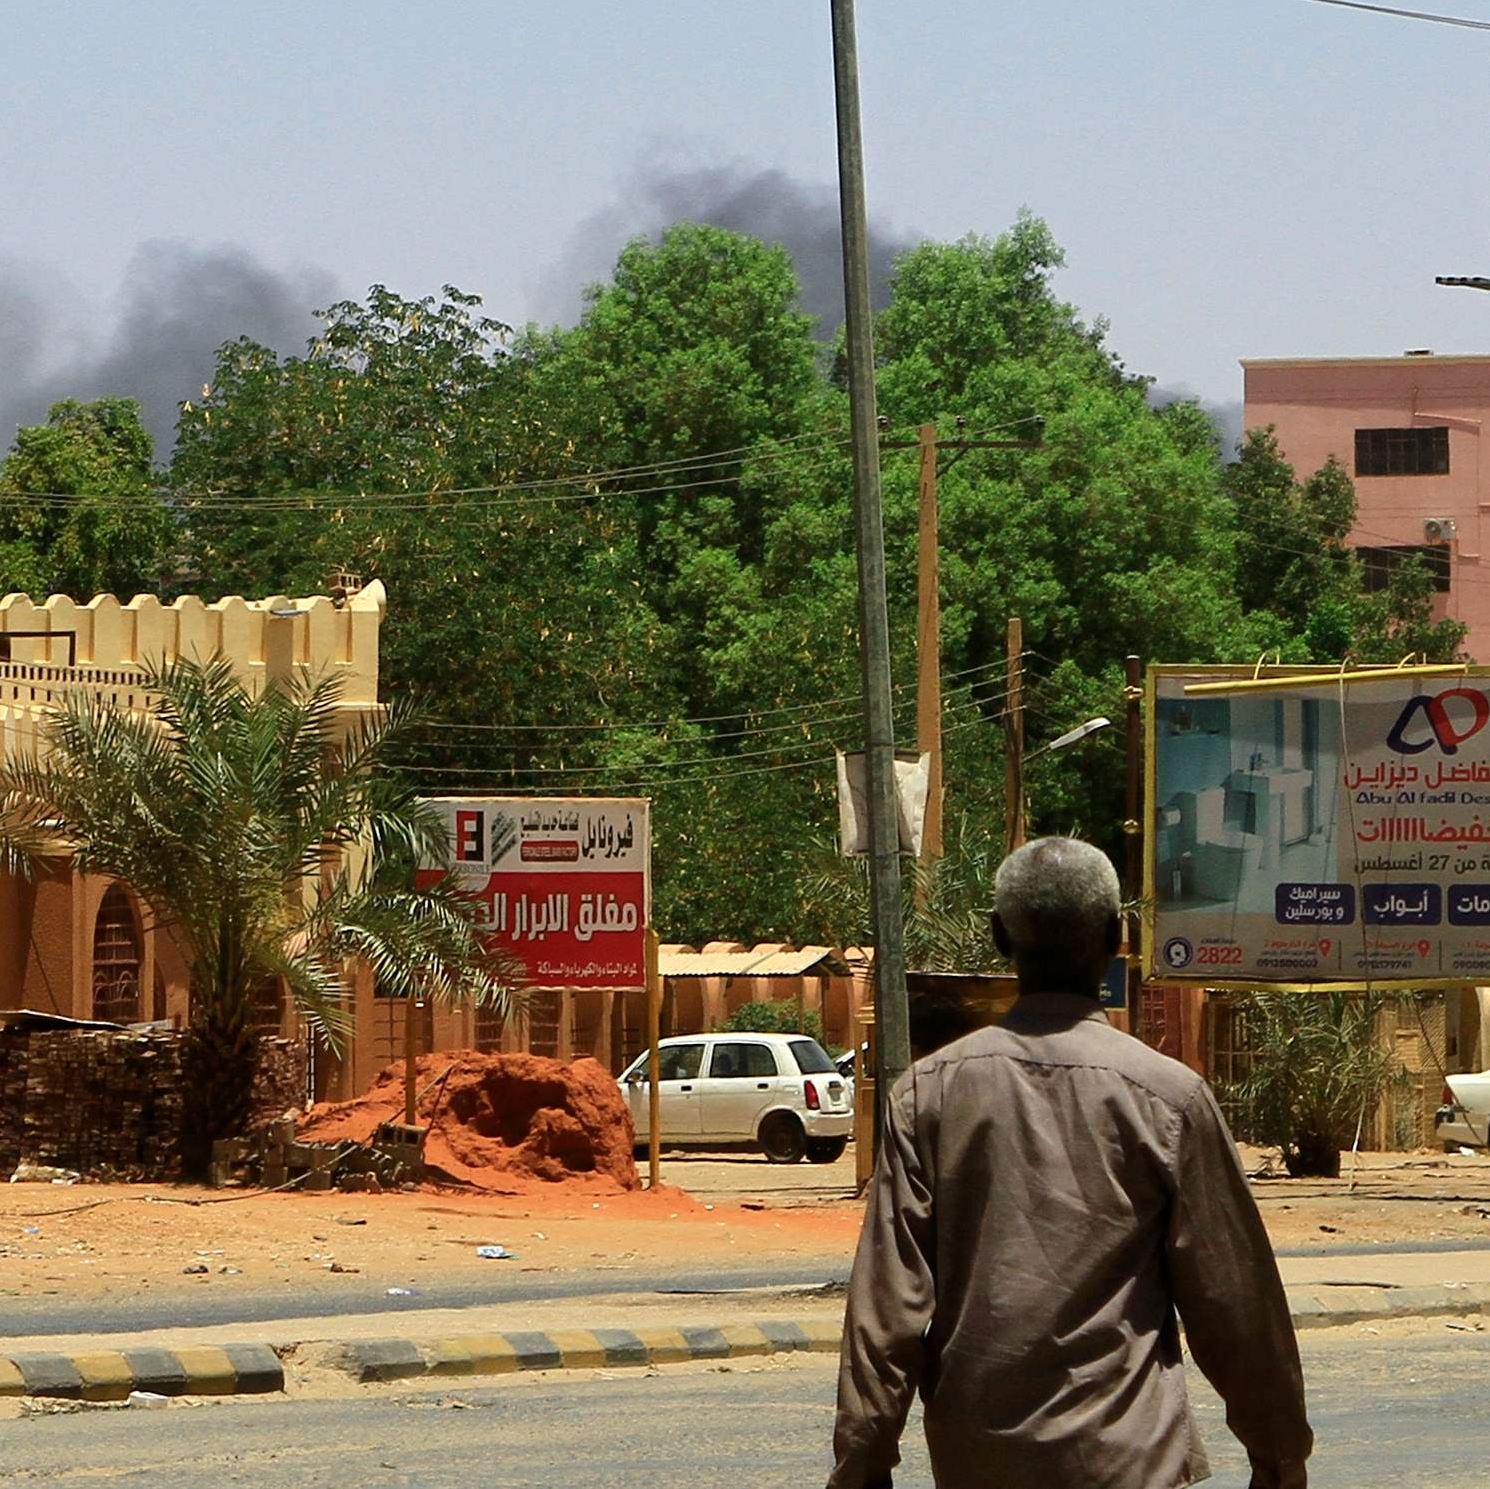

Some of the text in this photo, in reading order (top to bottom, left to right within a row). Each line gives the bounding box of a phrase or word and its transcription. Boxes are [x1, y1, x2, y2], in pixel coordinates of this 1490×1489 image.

[1344, 761, 1419, 790] ديزاين
[1356, 792, 1392, 804] Abu
[1397, 792, 1415, 804] Al
[1355, 851, 1423, 874] أغسطس
[1429, 855, 1450, 871] 27
[1454, 857, 1477, 874] من
[1289, 886, 1341, 901] سيراميك
[1373, 889, 1429, 917] أبواب
[1285, 904, 1334, 920] بورسلين
[1198, 946, 1243, 964] 2822
